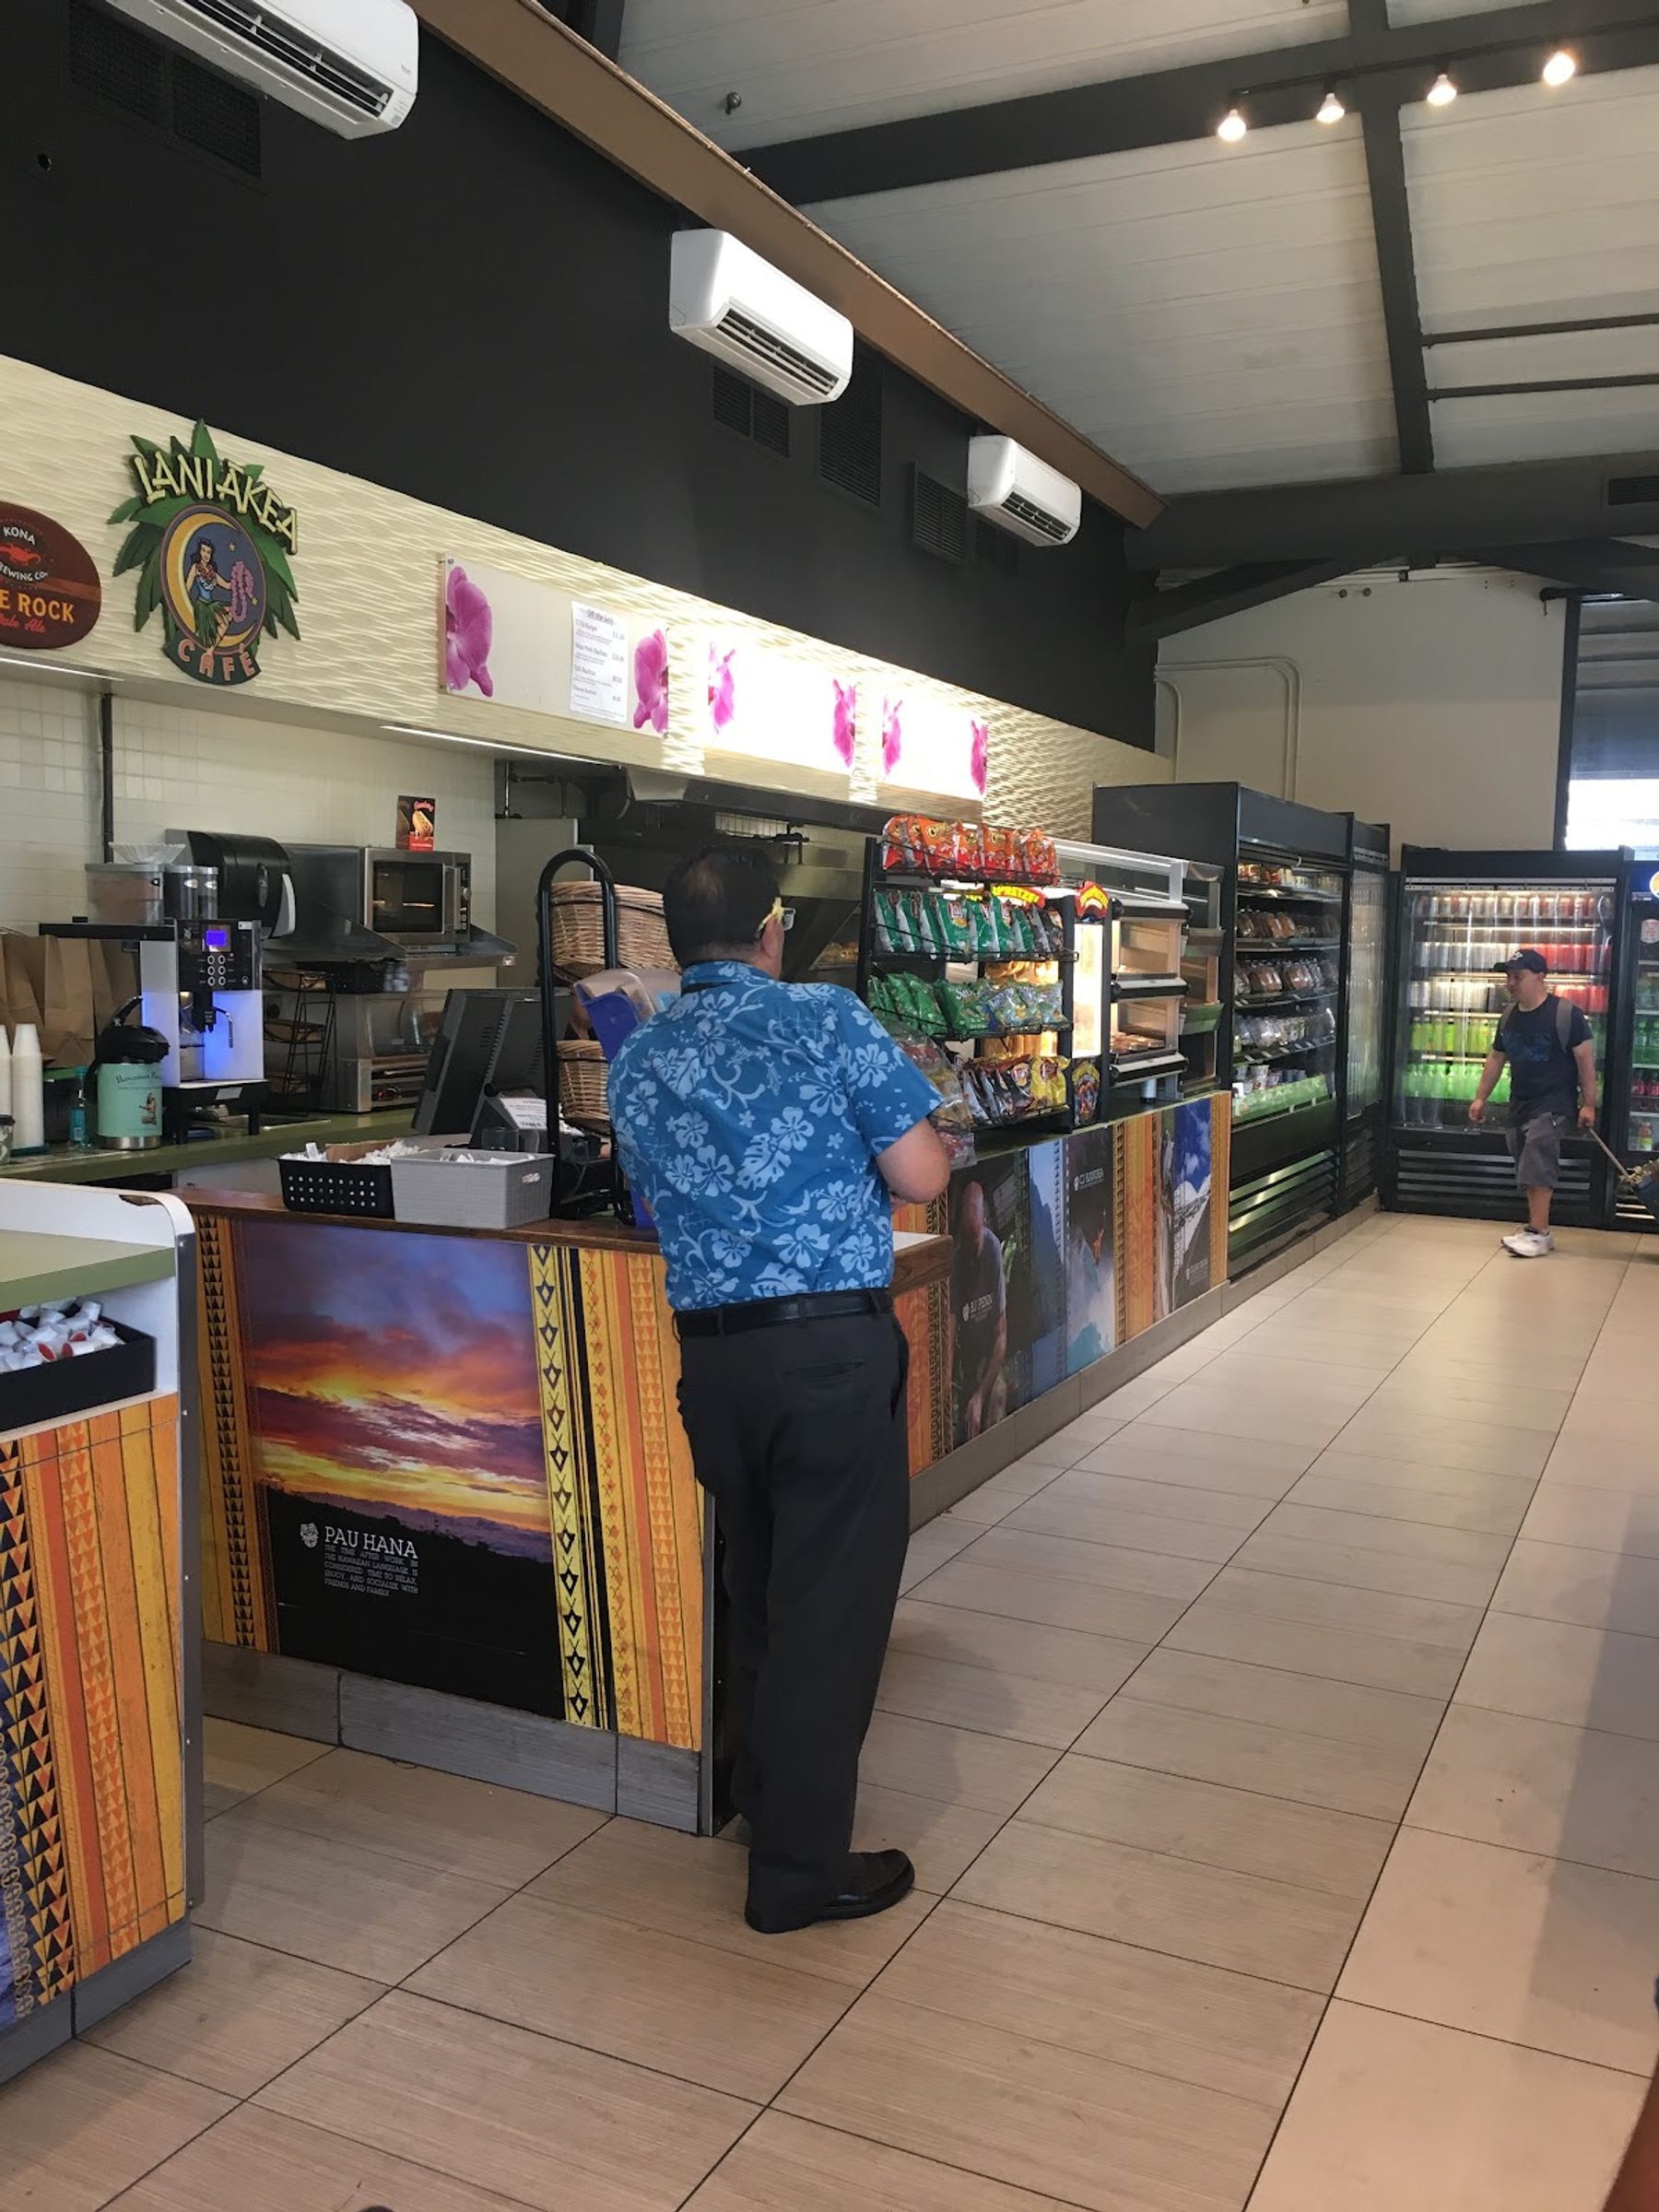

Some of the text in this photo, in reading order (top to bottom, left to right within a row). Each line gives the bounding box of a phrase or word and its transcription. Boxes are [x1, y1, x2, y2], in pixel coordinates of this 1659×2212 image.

[3, 526, 36, 546] KONA
[0, 561, 33, 582] REWING
[18, 593, 75, 624] ROCK
[324, 1526, 419, 1559] PAU HANA
